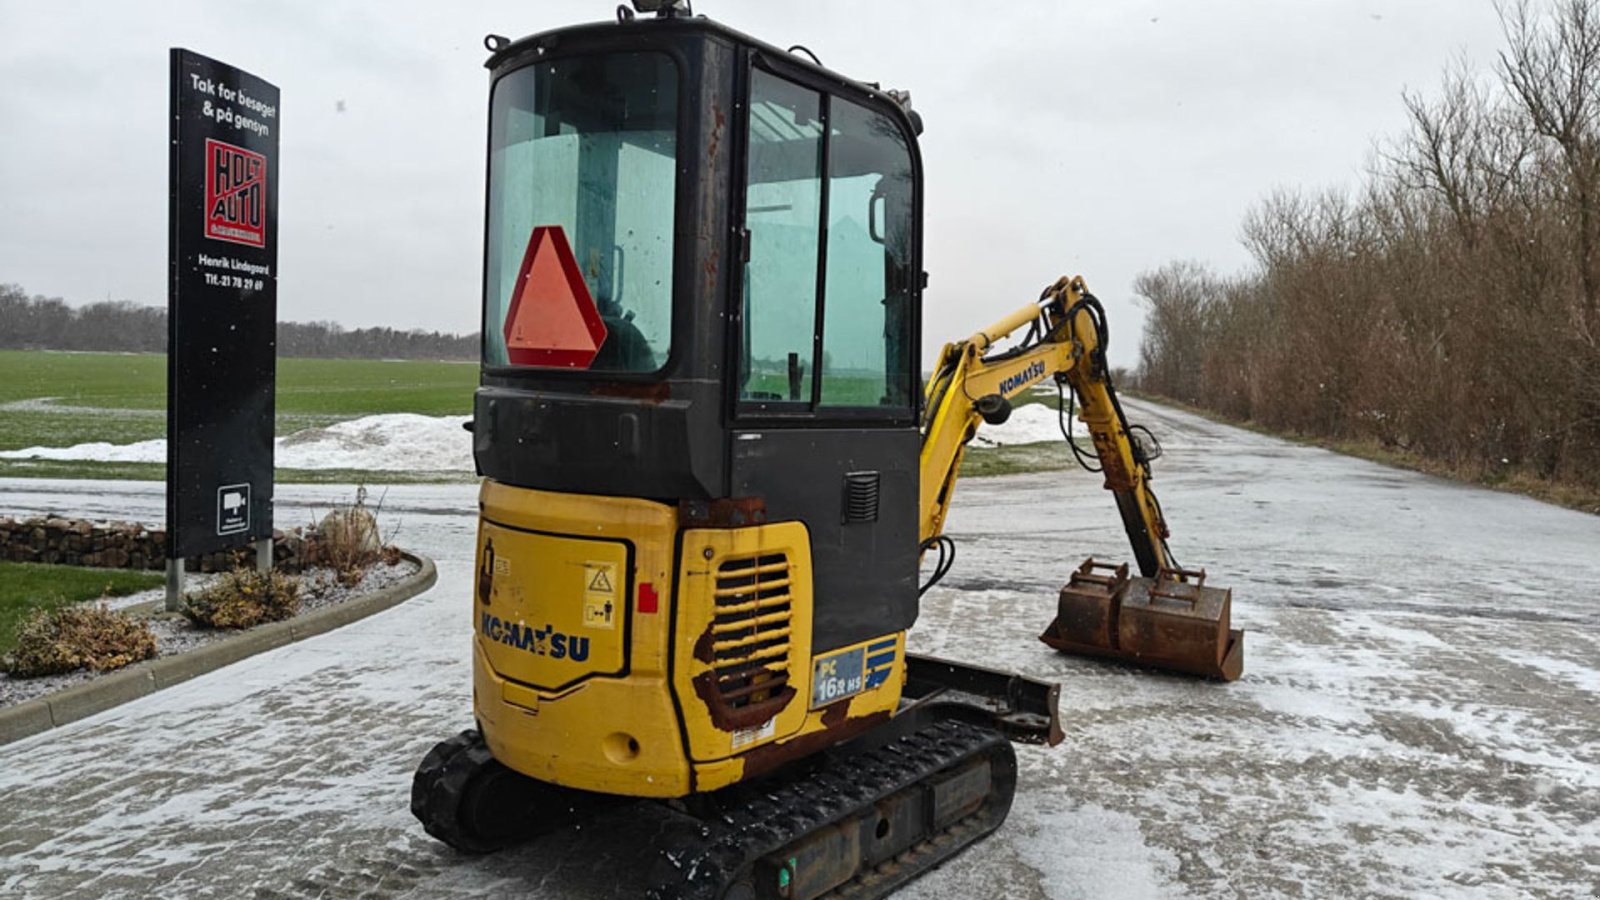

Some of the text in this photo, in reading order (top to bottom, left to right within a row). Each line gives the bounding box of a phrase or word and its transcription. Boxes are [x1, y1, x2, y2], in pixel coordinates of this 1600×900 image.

[190, 73, 216, 96] Tak
[217, 82, 237, 102] for
[202, 100, 269, 136] & på gensyn
[214, 147, 261, 197] HOLT
[212, 182, 261, 228] AUTO
[198, 253, 230, 269] Henrik
[999, 360, 1046, 396] KOMATSU
[481, 611, 590, 662] KOMATSU
[821, 659, 838, 679] PC
